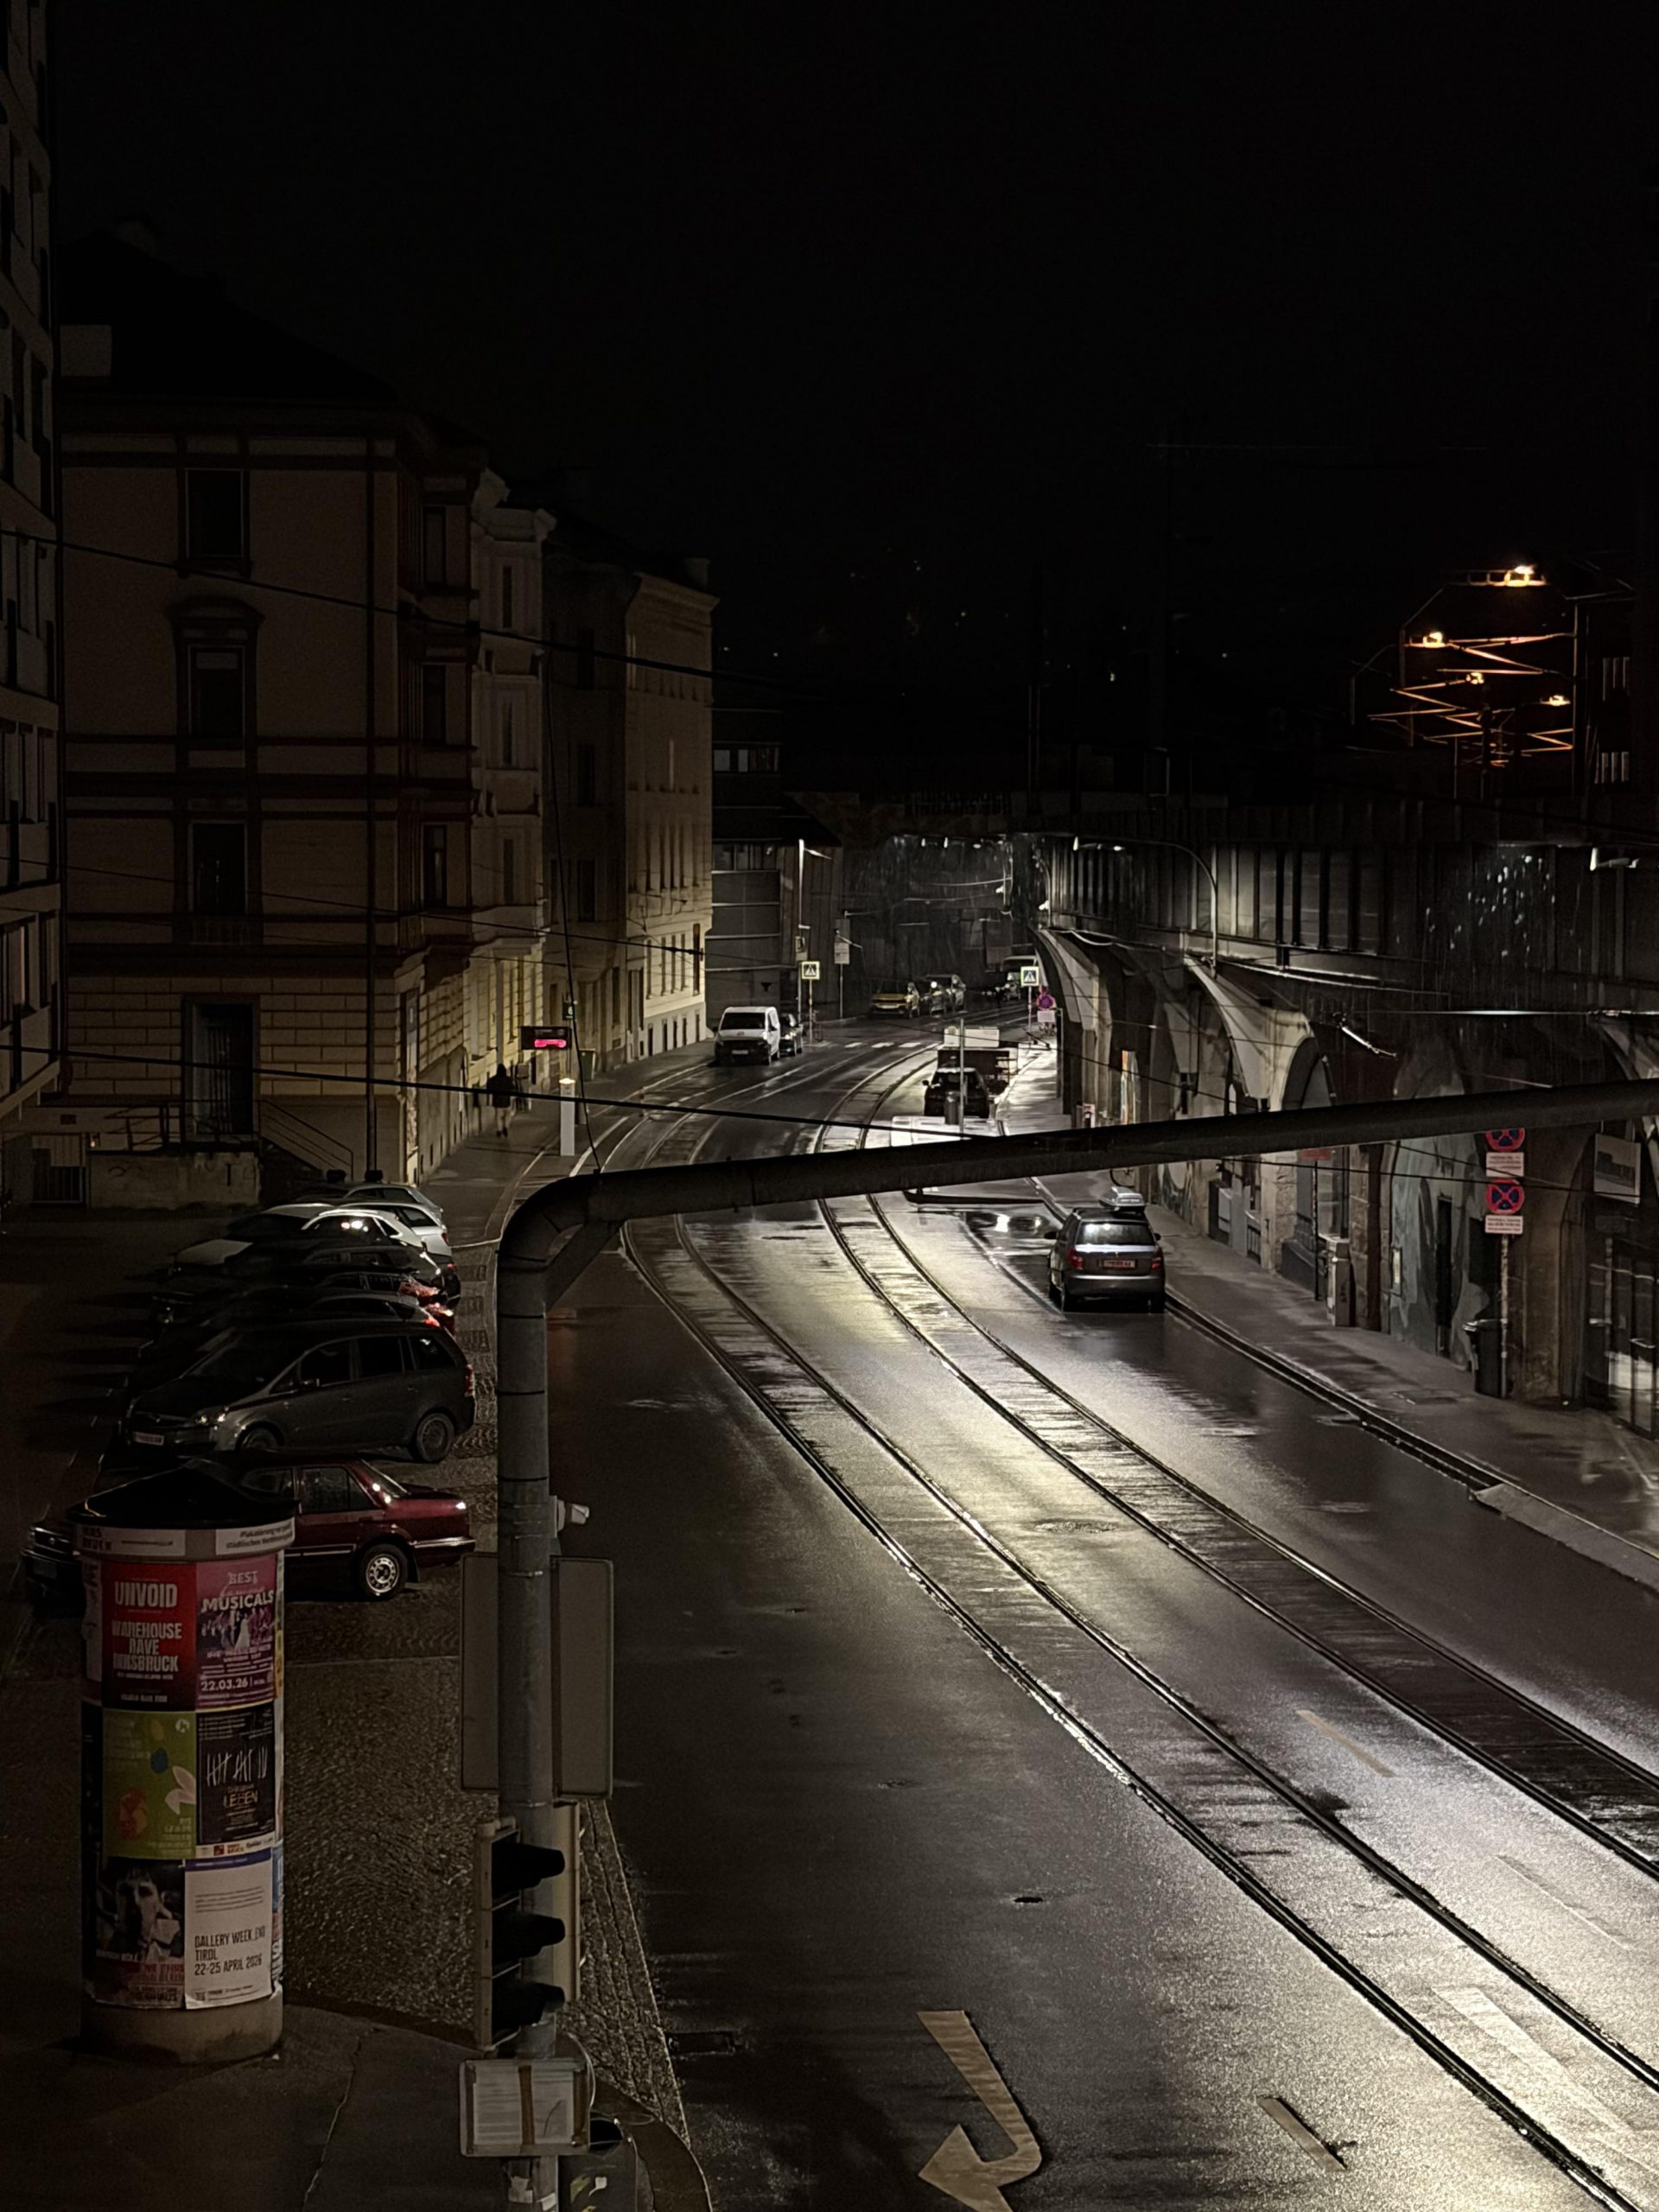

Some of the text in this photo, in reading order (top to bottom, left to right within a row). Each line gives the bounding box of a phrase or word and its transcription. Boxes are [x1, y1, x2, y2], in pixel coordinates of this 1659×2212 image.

[227, 1571, 258, 1585] BEST
[114, 1581, 178, 1608] UNVOID
[200, 1590, 275, 1612] MUSICALS
[111, 1619, 183, 1639] WAREHOUSE
[129, 1638, 159, 1655] RAVE
[112, 1652, 180, 1672] INNSBRUCK
[200, 1677, 249, 1692] 22.03.26
[194, 1932, 230, 1948] GALLERY
[195, 1948, 218, 1961] TIROL
[194, 1961, 221, 1976] 22-25
[223, 1958, 245, 1973] APRIL
[245, 1953, 263, 1969] 2026
